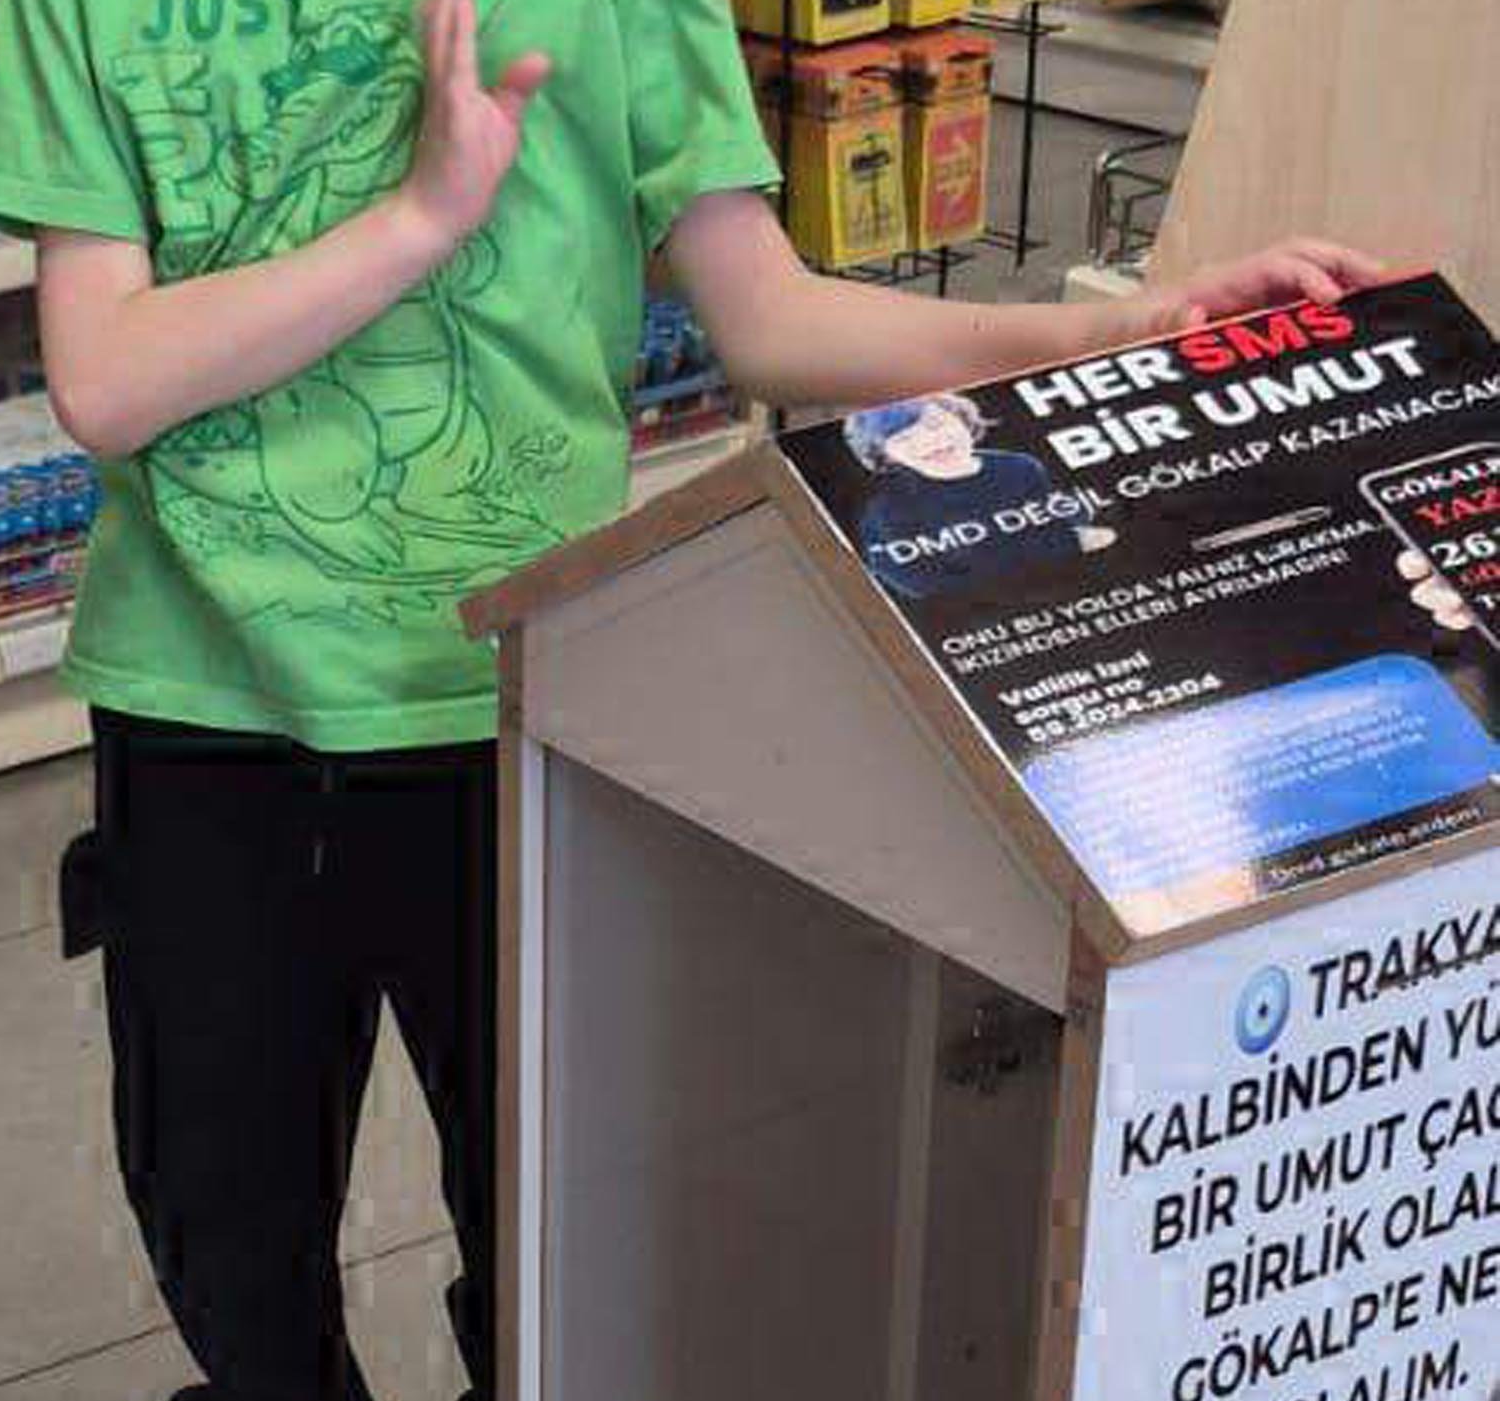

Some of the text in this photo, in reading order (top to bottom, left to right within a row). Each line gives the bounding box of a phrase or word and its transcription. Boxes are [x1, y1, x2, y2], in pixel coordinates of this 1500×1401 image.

[1013, 302, 1354, 418] HER SMS
[1047, 337, 1424, 471] BİR UMUT
[1116, 441, 1271, 498] GÖKALP
[942, 624, 1010, 655] ONU
[1056, 583, 1155, 621] YOLDA
[1119, 1017, 1429, 1177] KALBİNDEN
[1151, 1168, 1238, 1253] BİR
[1255, 1113, 1407, 1213] UMUT
[1204, 1205, 1370, 1320] BİRLİK
